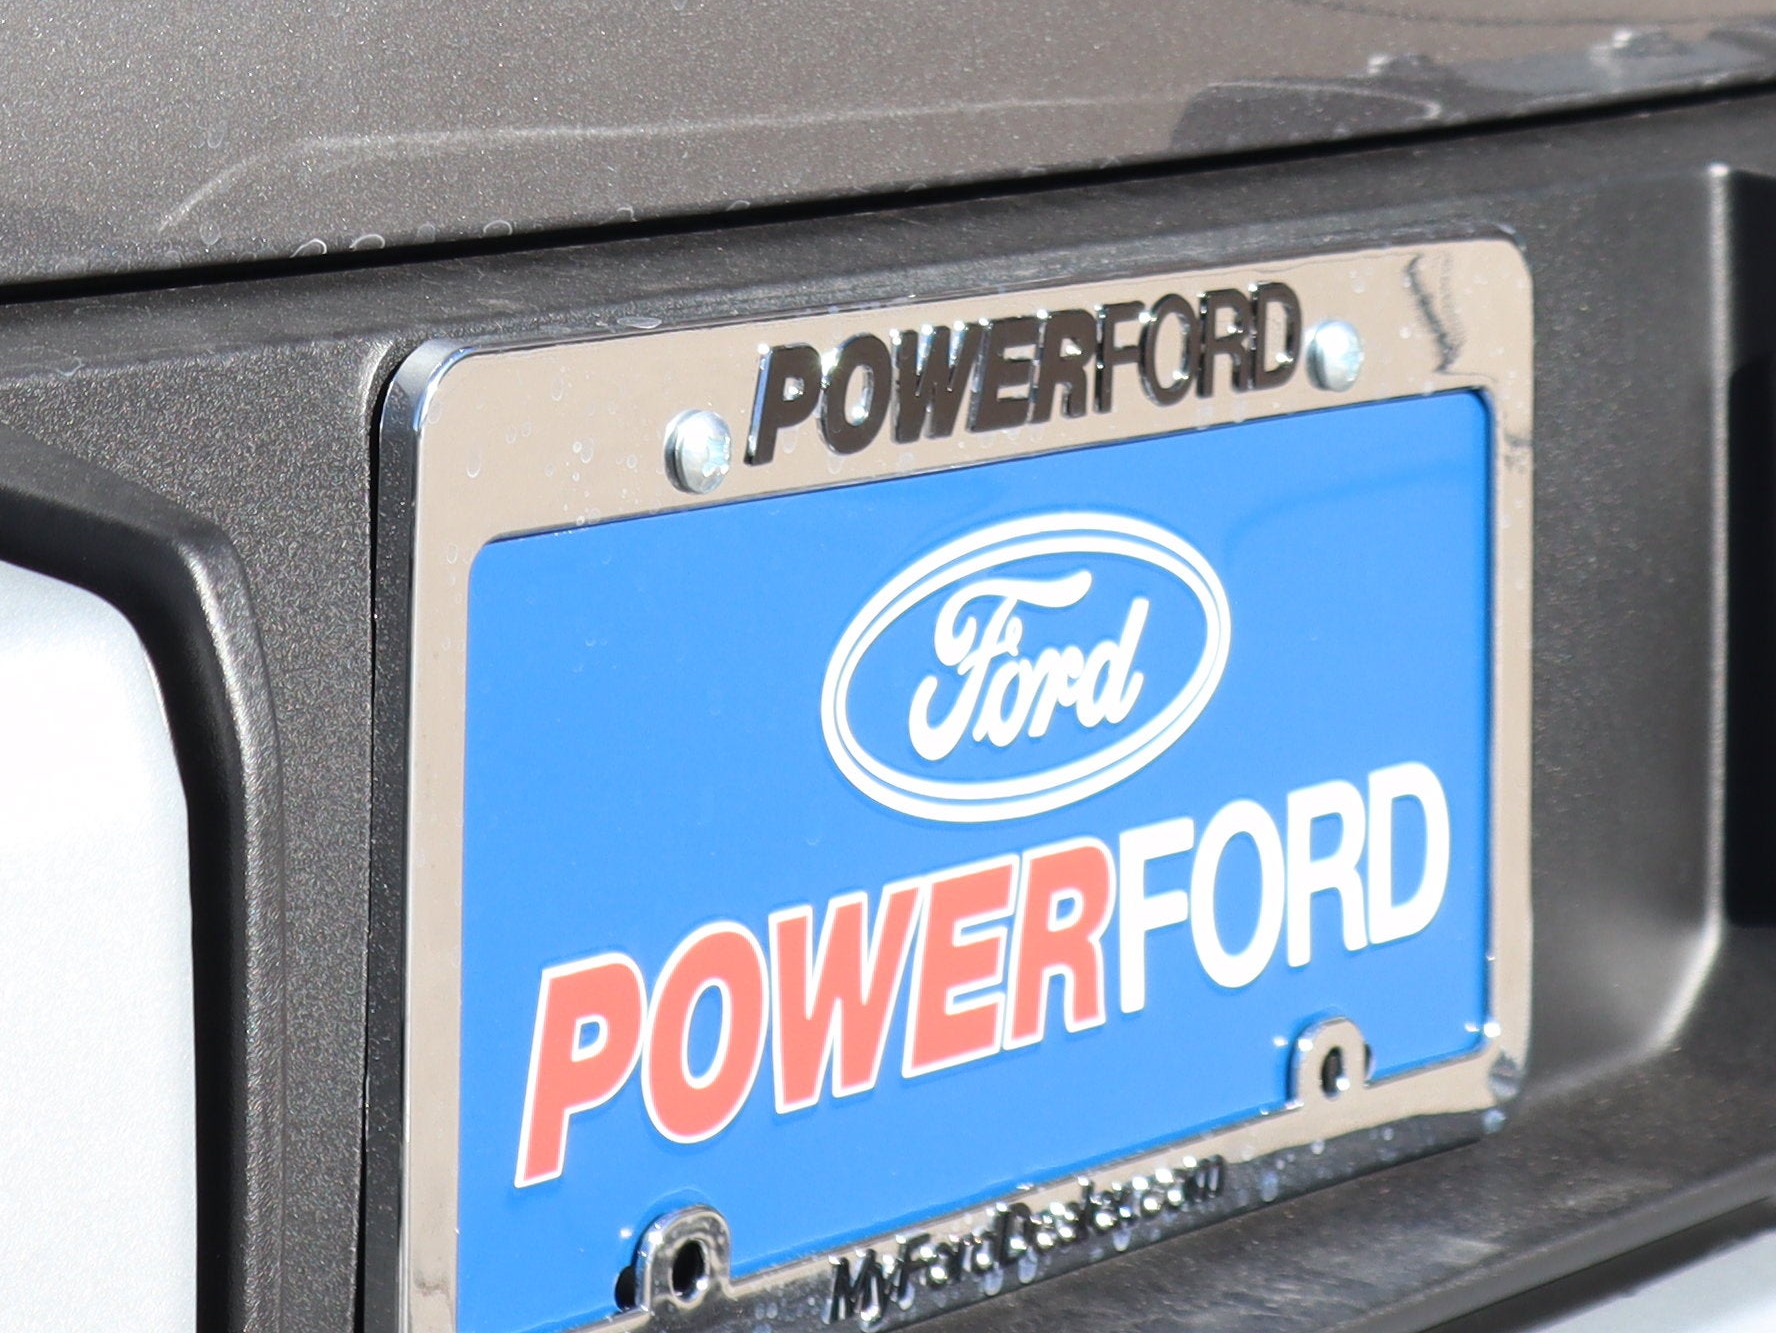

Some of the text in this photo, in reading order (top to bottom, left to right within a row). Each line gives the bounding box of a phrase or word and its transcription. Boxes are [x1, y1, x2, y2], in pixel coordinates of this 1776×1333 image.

[742, 281, 1304, 466] POWERFORD
[908, 569, 1150, 761] Ford
[514, 761, 1452, 1187] POWERFORD
